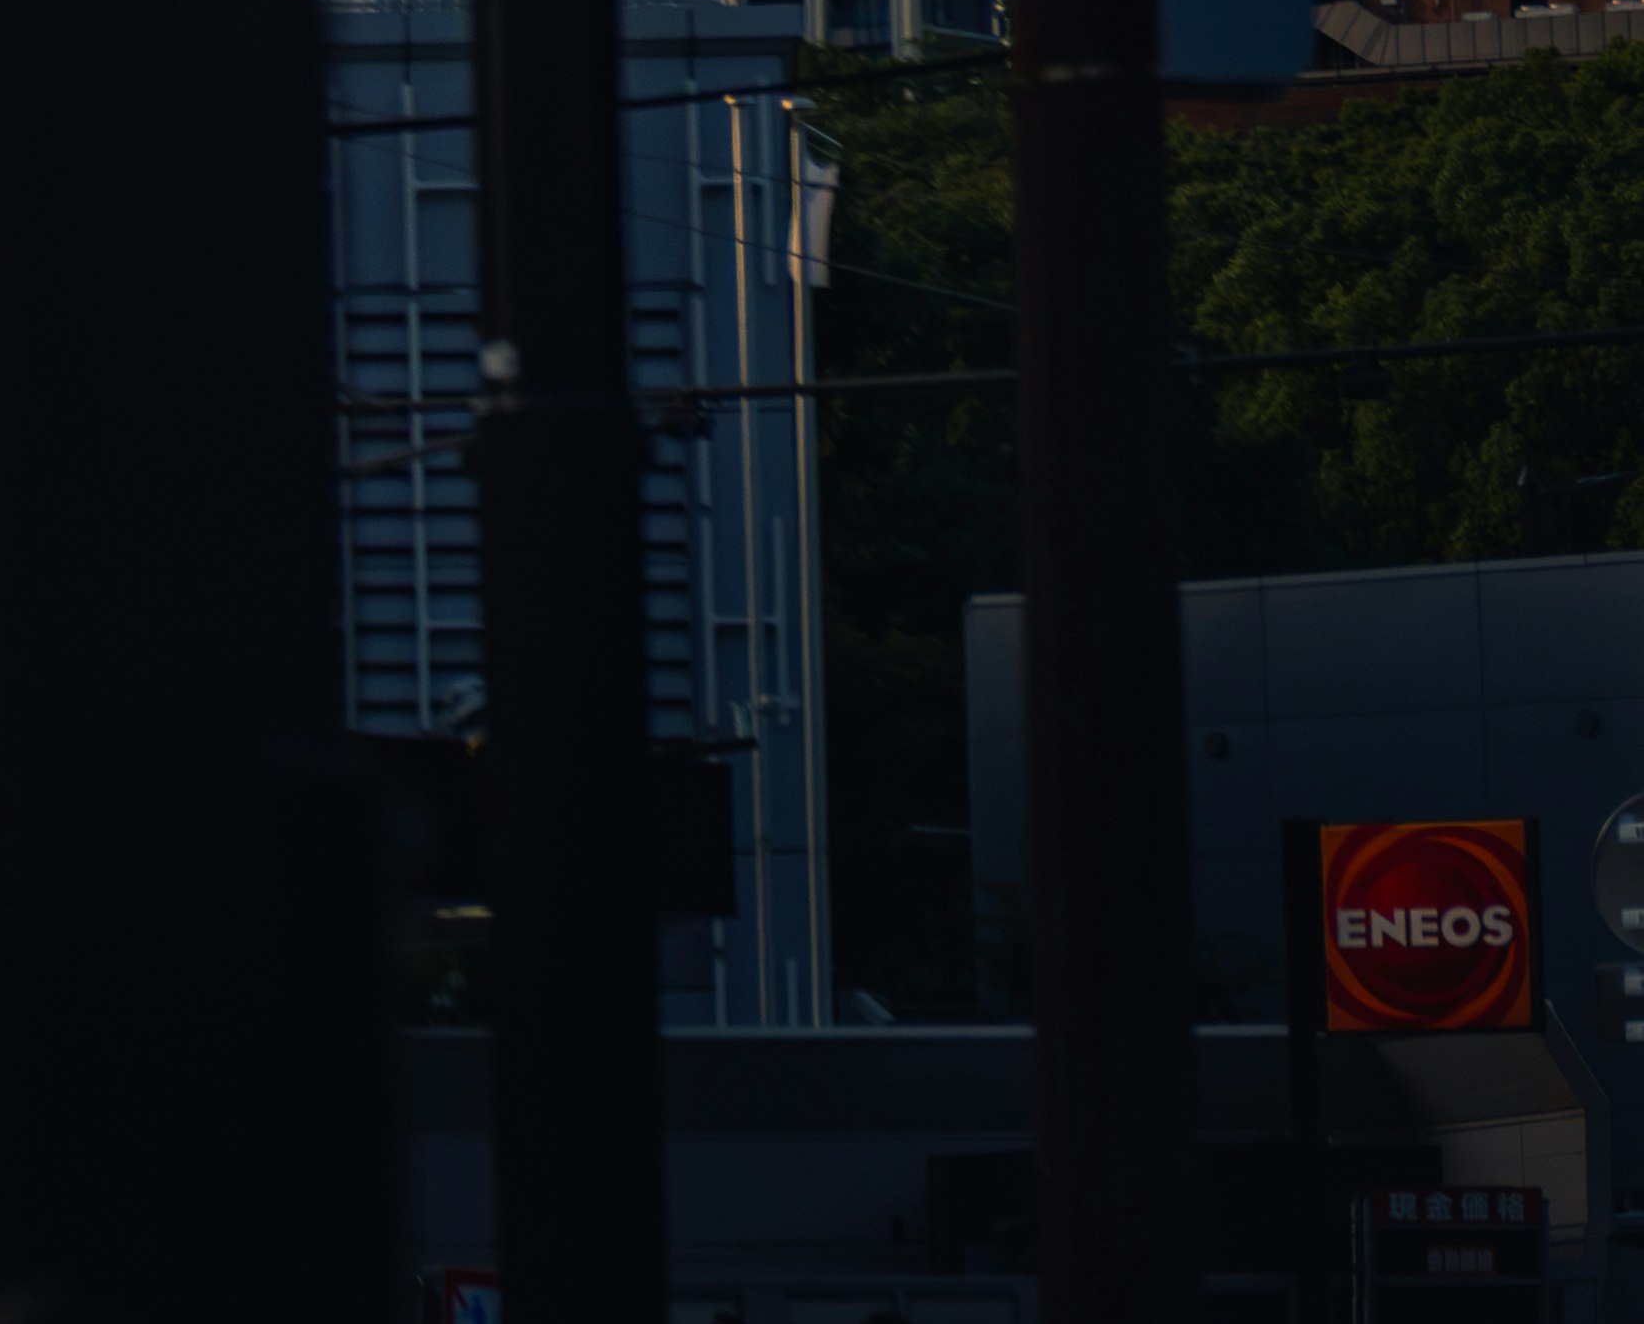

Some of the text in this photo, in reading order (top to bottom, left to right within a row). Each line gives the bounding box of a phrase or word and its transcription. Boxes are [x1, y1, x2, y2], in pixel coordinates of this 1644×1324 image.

[1335, 904, 1515, 949] ENEOS
[1389, 1190, 1525, 1222] 現金価格
